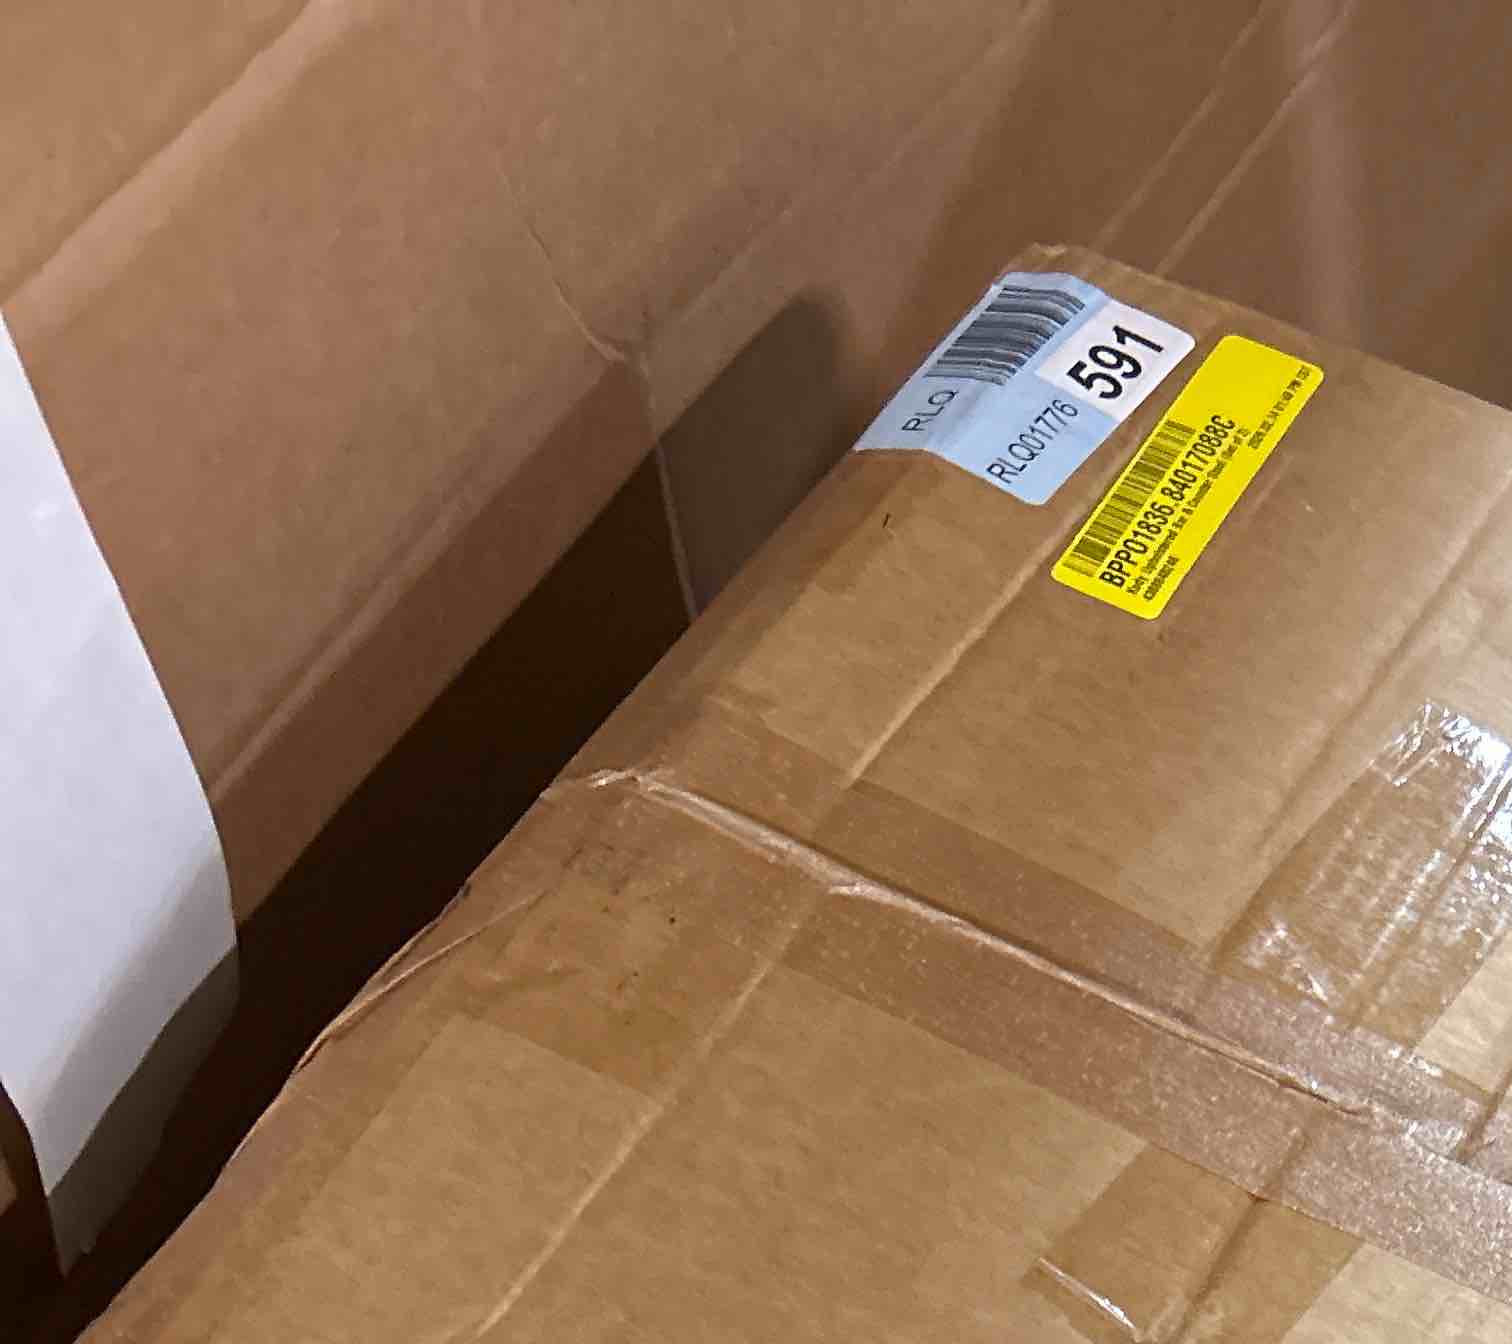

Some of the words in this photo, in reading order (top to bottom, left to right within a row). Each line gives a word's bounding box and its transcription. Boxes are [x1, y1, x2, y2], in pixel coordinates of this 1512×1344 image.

[1066, 325, 1165, 400] 591
[902, 388, 959, 433] RLQ
[987, 397, 1080, 484] RLQ01776
